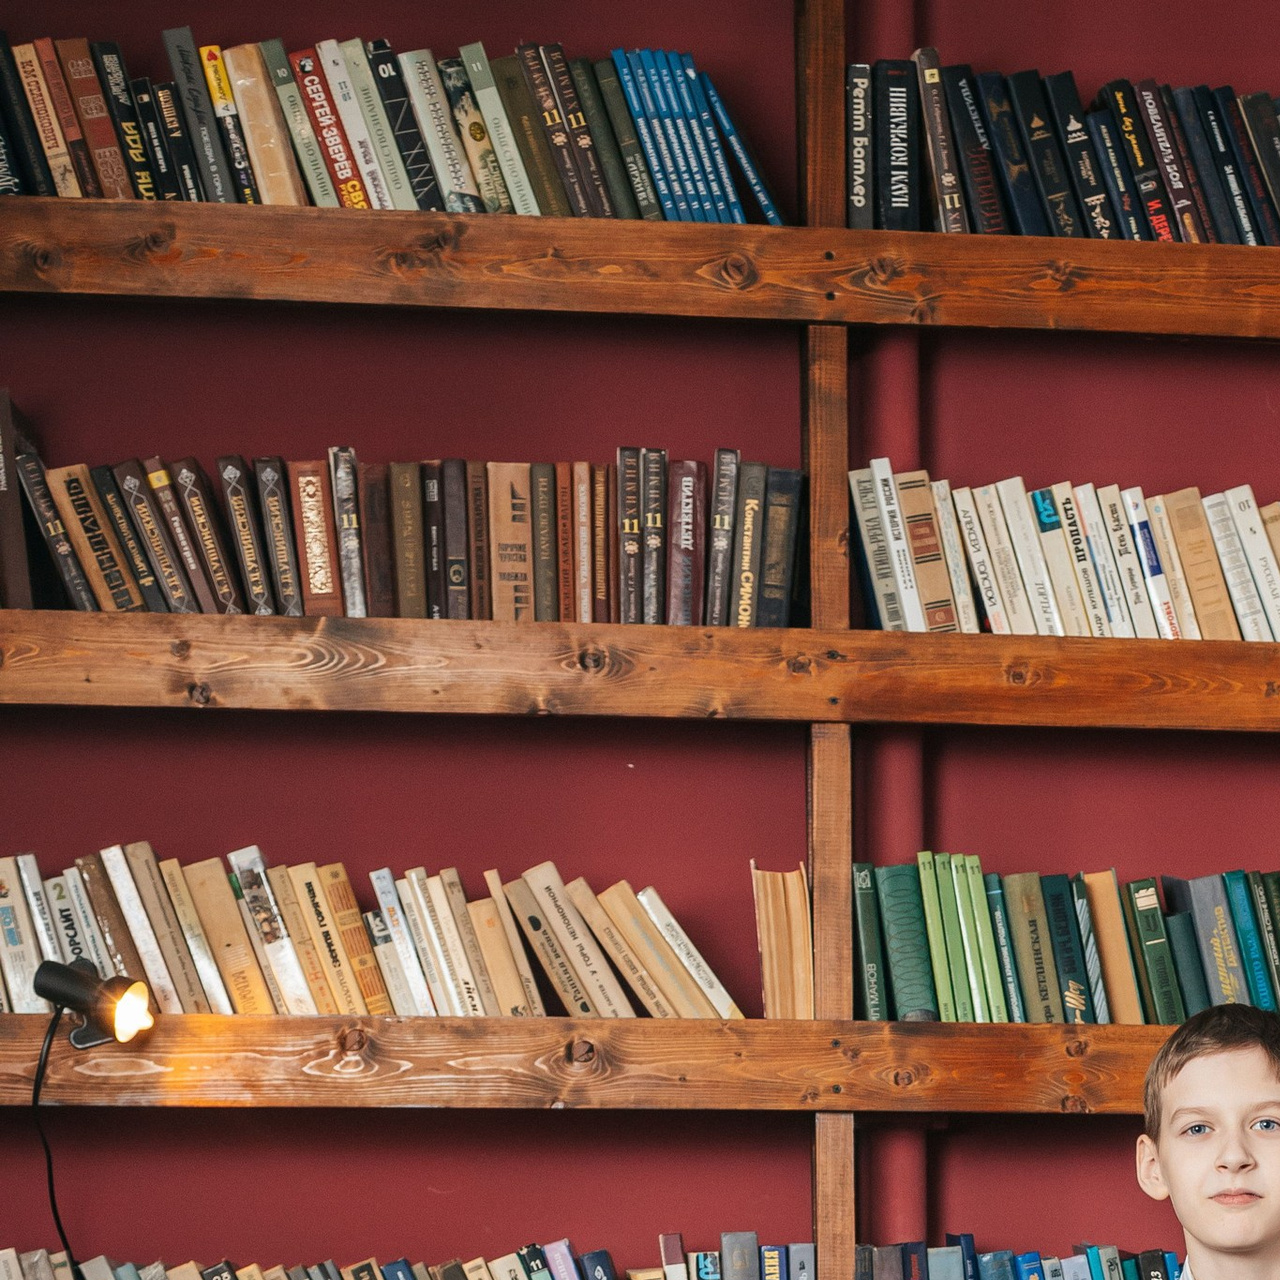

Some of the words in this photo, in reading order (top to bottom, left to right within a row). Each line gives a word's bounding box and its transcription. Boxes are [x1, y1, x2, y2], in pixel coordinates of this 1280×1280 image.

[302, 74, 334, 127] СЕРГЕЙ
[543, 109, 562, 126] 11
[568, 110, 587, 127] 11
[853, 78, 868, 130] Ретт
[121, 119, 145, 164] АДА
[359, 83, 403, 190] ОБЩЕСТВОЗНАНИЕ
[889, 85, 909, 165] КОРЖАВИН
[199, 126, 215, 162] ПОЕЗДКА
[211, 173, 223, 194] ГОРЫ
[627, 161, 649, 201] АРХИВ
[654, 171, 663, 179] И
[852, 137, 870, 206] Батлер
[1166, 162, 1183, 189] БОЯ
[892, 169, 911, 208] НАУМ
[944, 193, 961, 210] 11
[626, 458, 636, 513] ХИМИЯ
[650, 452, 660, 508] ХИМИЯ
[880, 476, 894, 506] РОССИИ
[680, 475, 695, 549] ДЕТЕКТИВ
[886, 508, 901, 541] ИСТОРИЯ
[1060, 495, 1086, 563] ПРОПАСТЬ
[169, 515, 197, 571] Геометрия
[961, 508, 981, 553] АЛЕКСЕЙ
[974, 560, 996, 607] ТОЛСТОЙ
[1079, 566, 1098, 610] КУЛЕШОВ
[544, 883, 580, 941] НЕПОКОРНОЙ
[538, 926, 563, 961] весна
[575, 941, 595, 968] ГОРЫ
[1027, 919, 1050, 1001] КЕТЛИНСКАЯ
[555, 959, 584, 1003] Ранняя
[587, 966, 599, 977] У
[867, 963, 878, 1004] МАНОВ
[1252, 960, 1270, 1006] ОДНОГО
[1042, 1004, 1055, 1026] ера
